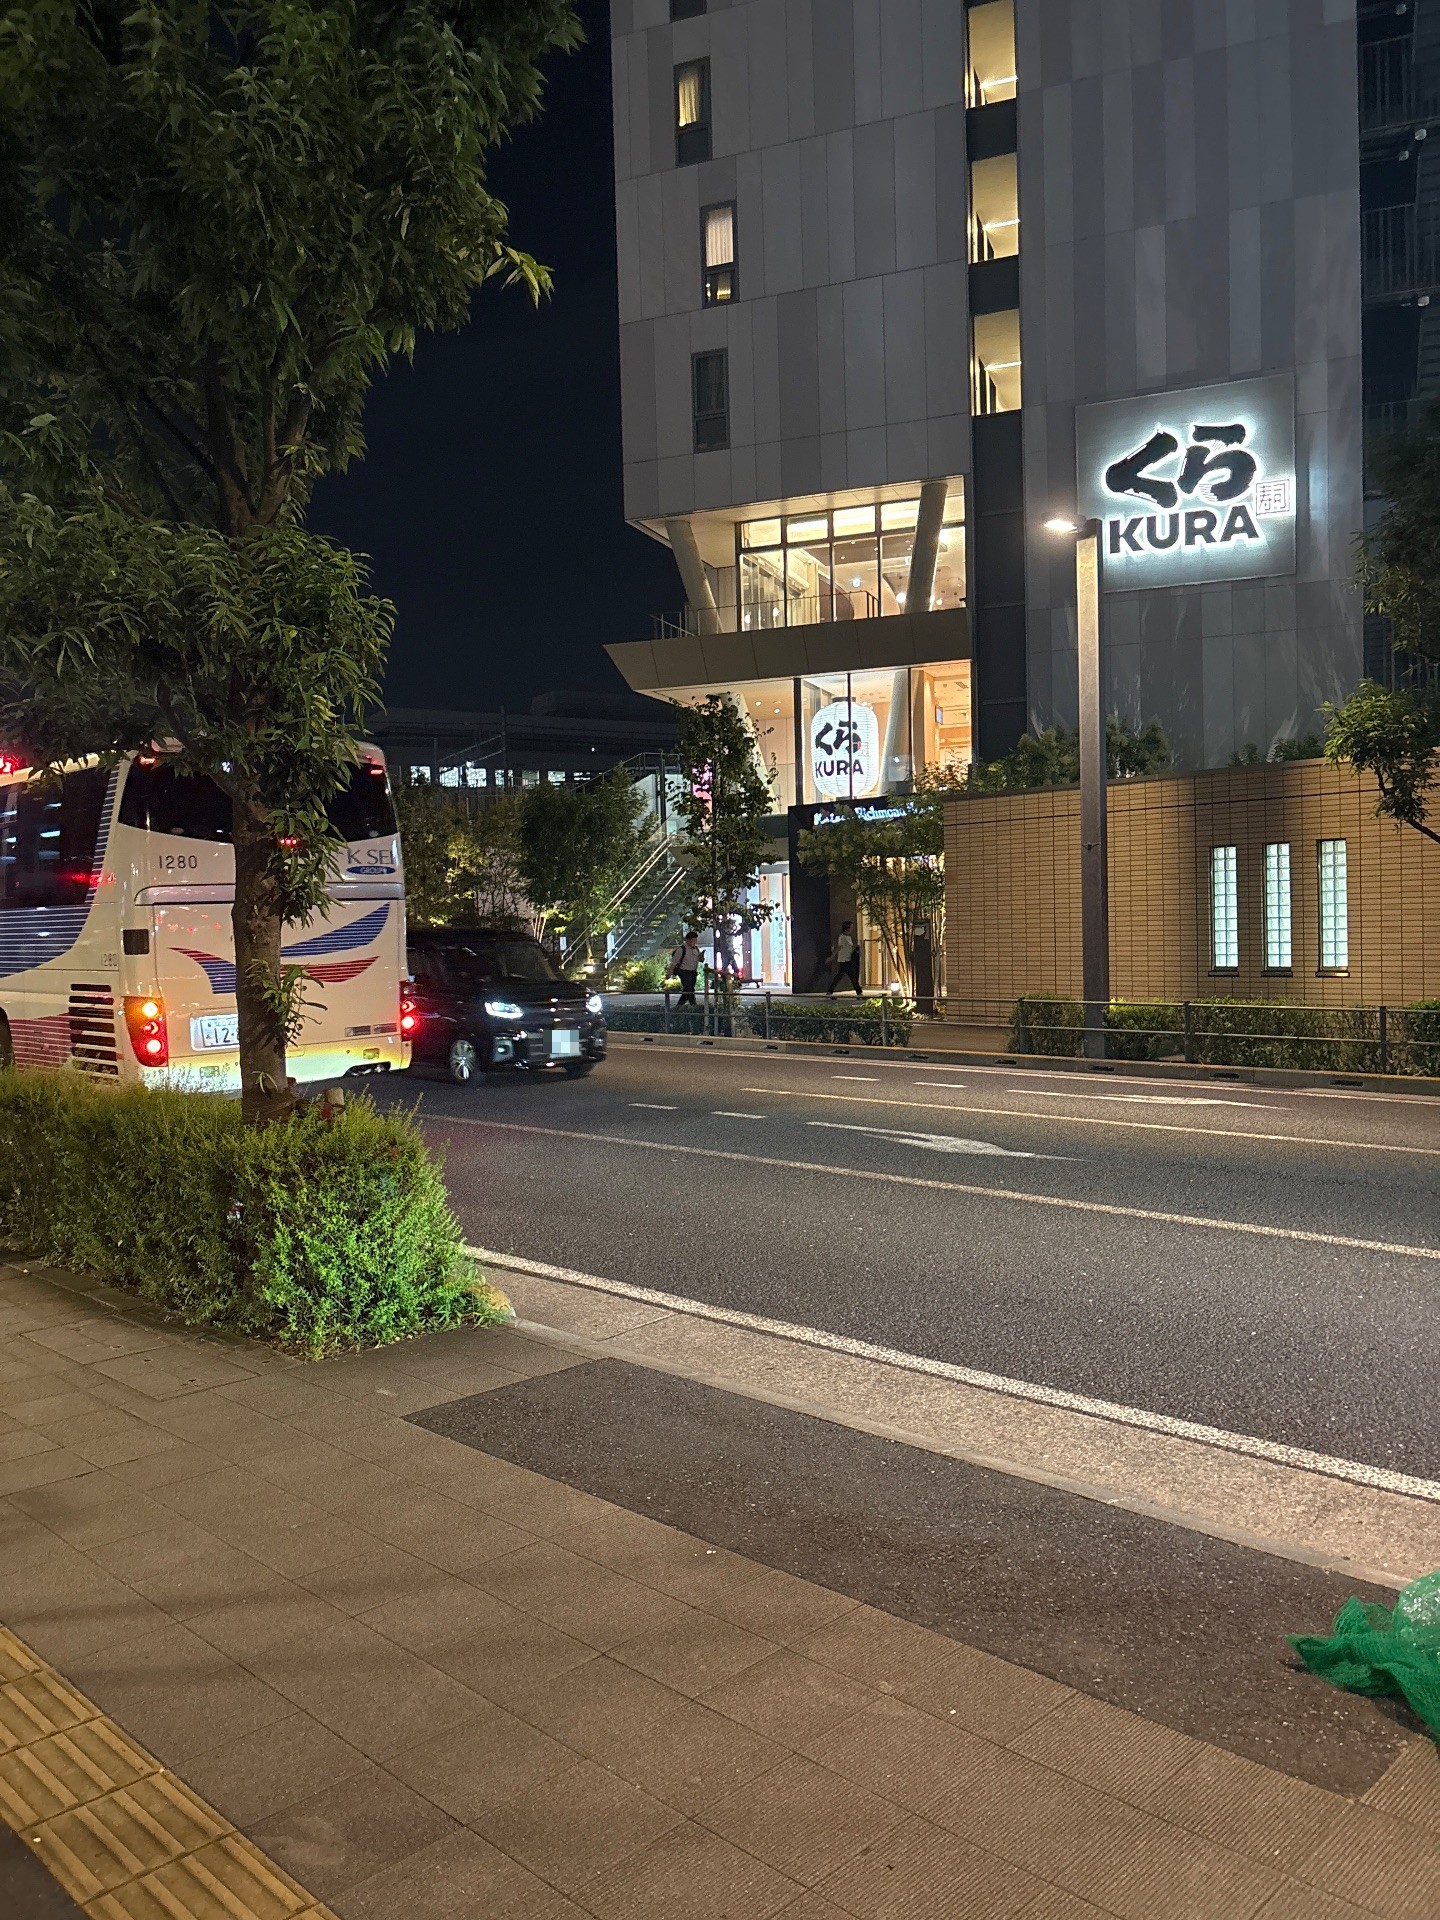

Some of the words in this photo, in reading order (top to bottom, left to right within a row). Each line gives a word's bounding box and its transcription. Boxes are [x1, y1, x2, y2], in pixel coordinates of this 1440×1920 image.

[1105, 423, 1258, 509] くら
[1109, 505, 1260, 554] KURA
[815, 719, 862, 756] くら
[815, 759, 864, 779] KURA
[158, 855, 198, 869] 1280
